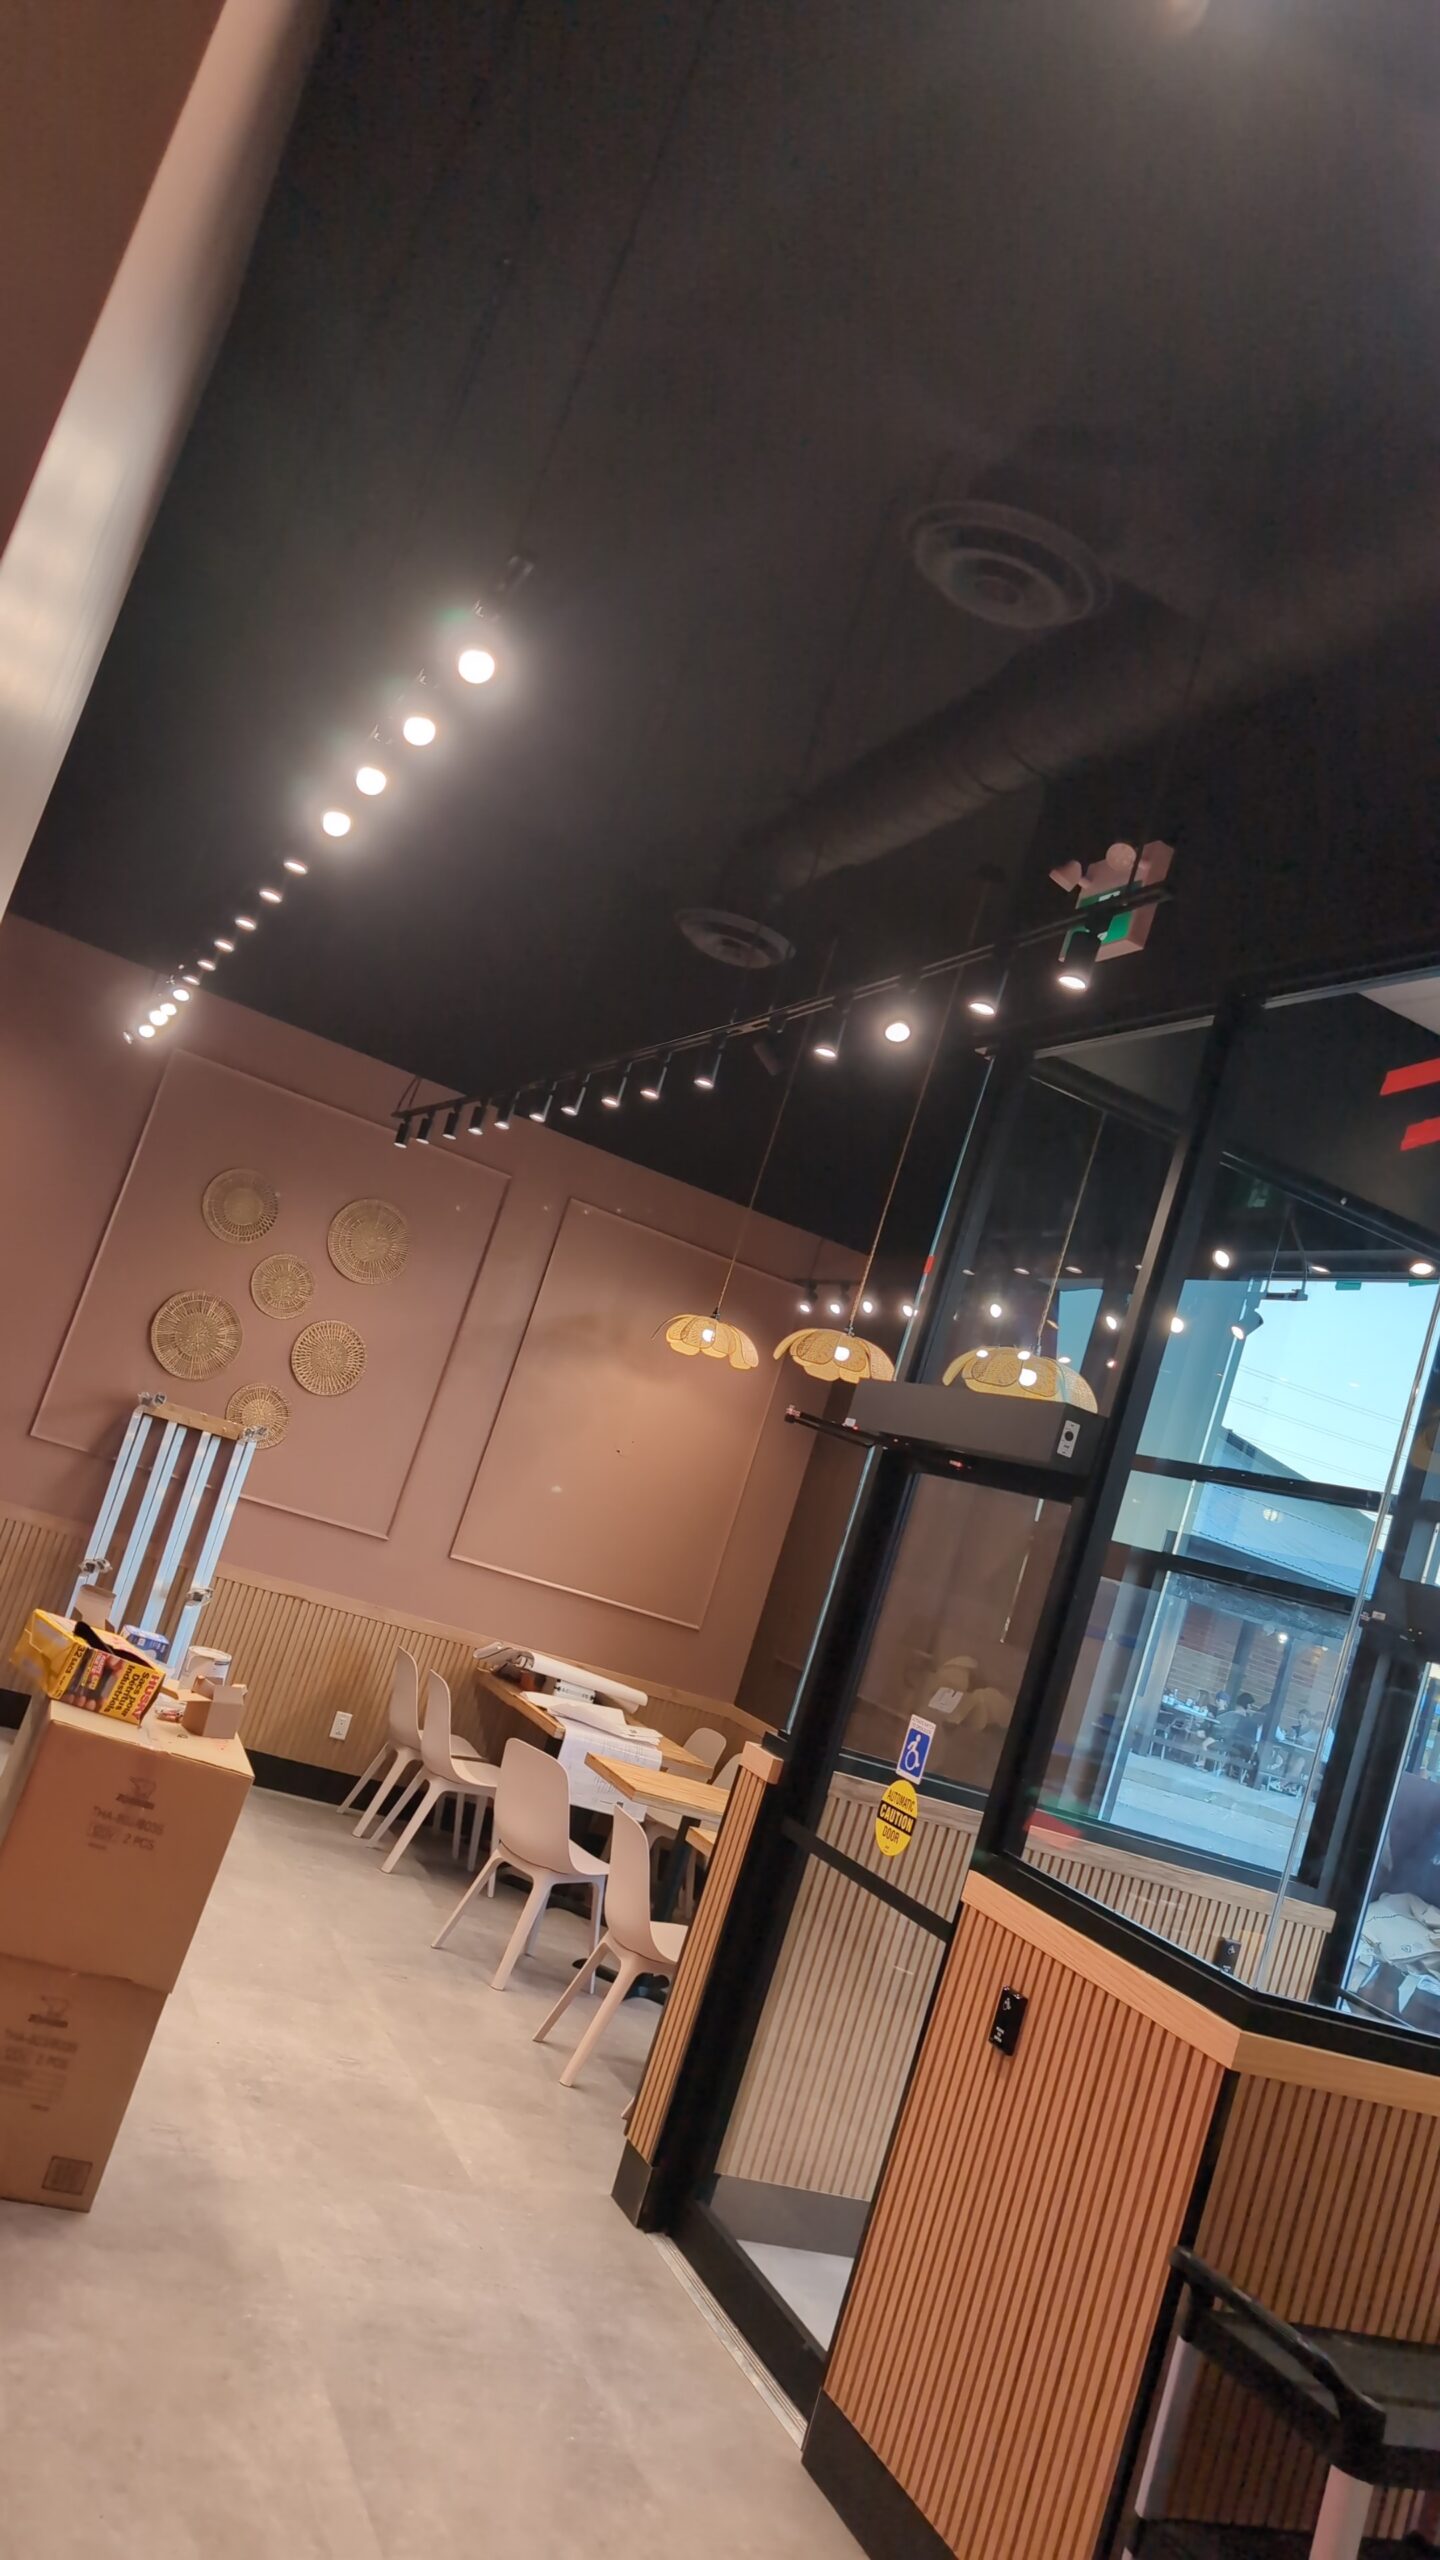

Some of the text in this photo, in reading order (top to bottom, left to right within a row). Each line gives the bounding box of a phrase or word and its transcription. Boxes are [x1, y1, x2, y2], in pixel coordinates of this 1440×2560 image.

[121, 1671, 150, 1717] Sacs pour
[131, 1674, 160, 1720] HUSKY
[887, 1789, 915, 1812] AUTOMATIC
[880, 1803, 914, 1833] CAUTION
[882, 1825, 900, 1844] DOOR
